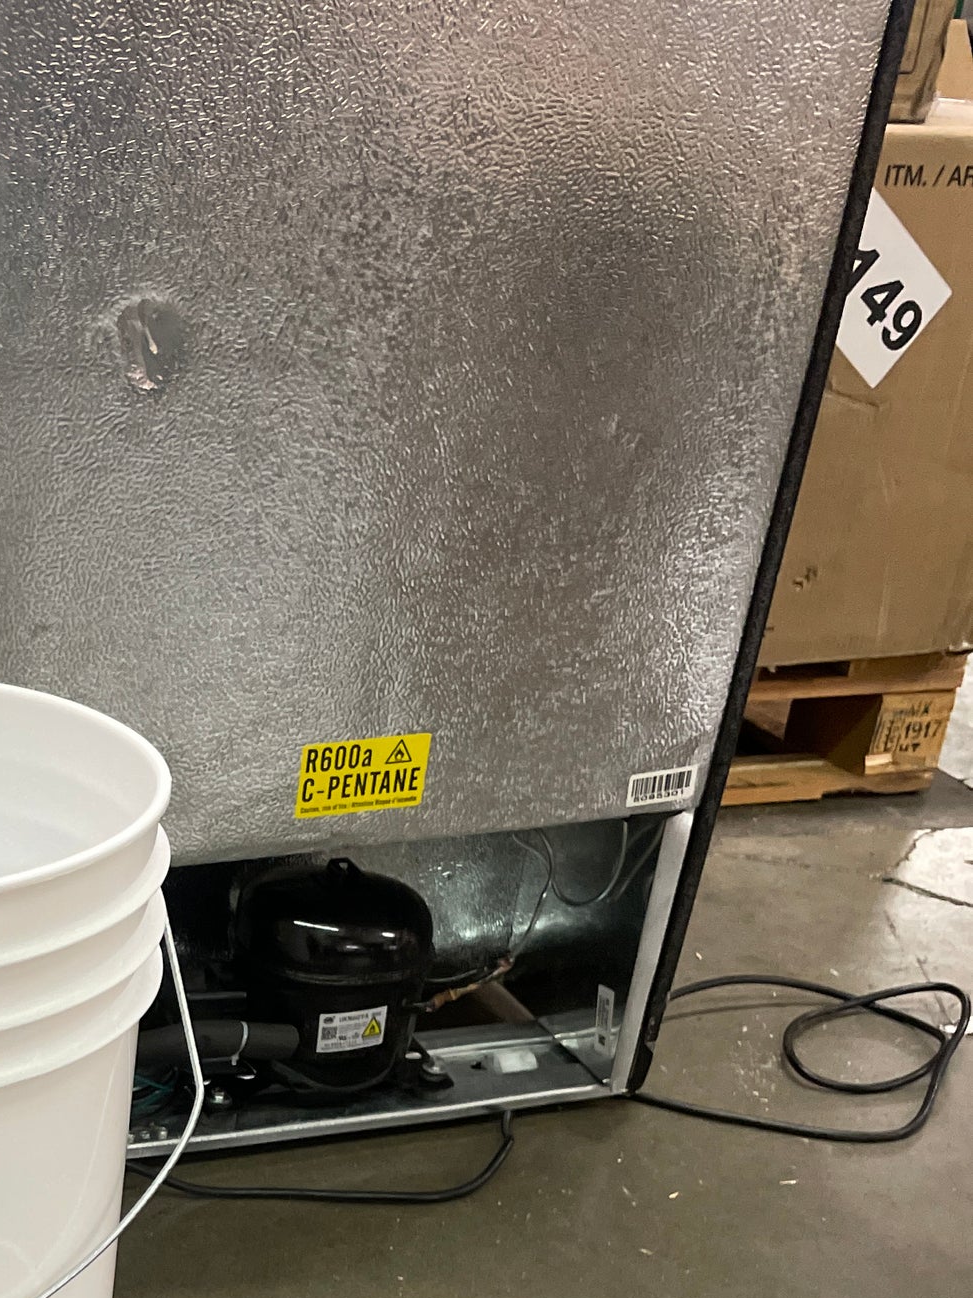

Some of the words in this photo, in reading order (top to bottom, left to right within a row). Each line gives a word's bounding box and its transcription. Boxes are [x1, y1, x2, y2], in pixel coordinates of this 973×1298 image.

[884, 164, 927, 187] ITM.
[932, 164, 946, 187] /
[305, 744, 373, 774] R600a
[301, 767, 421, 803] C-PENTANE
